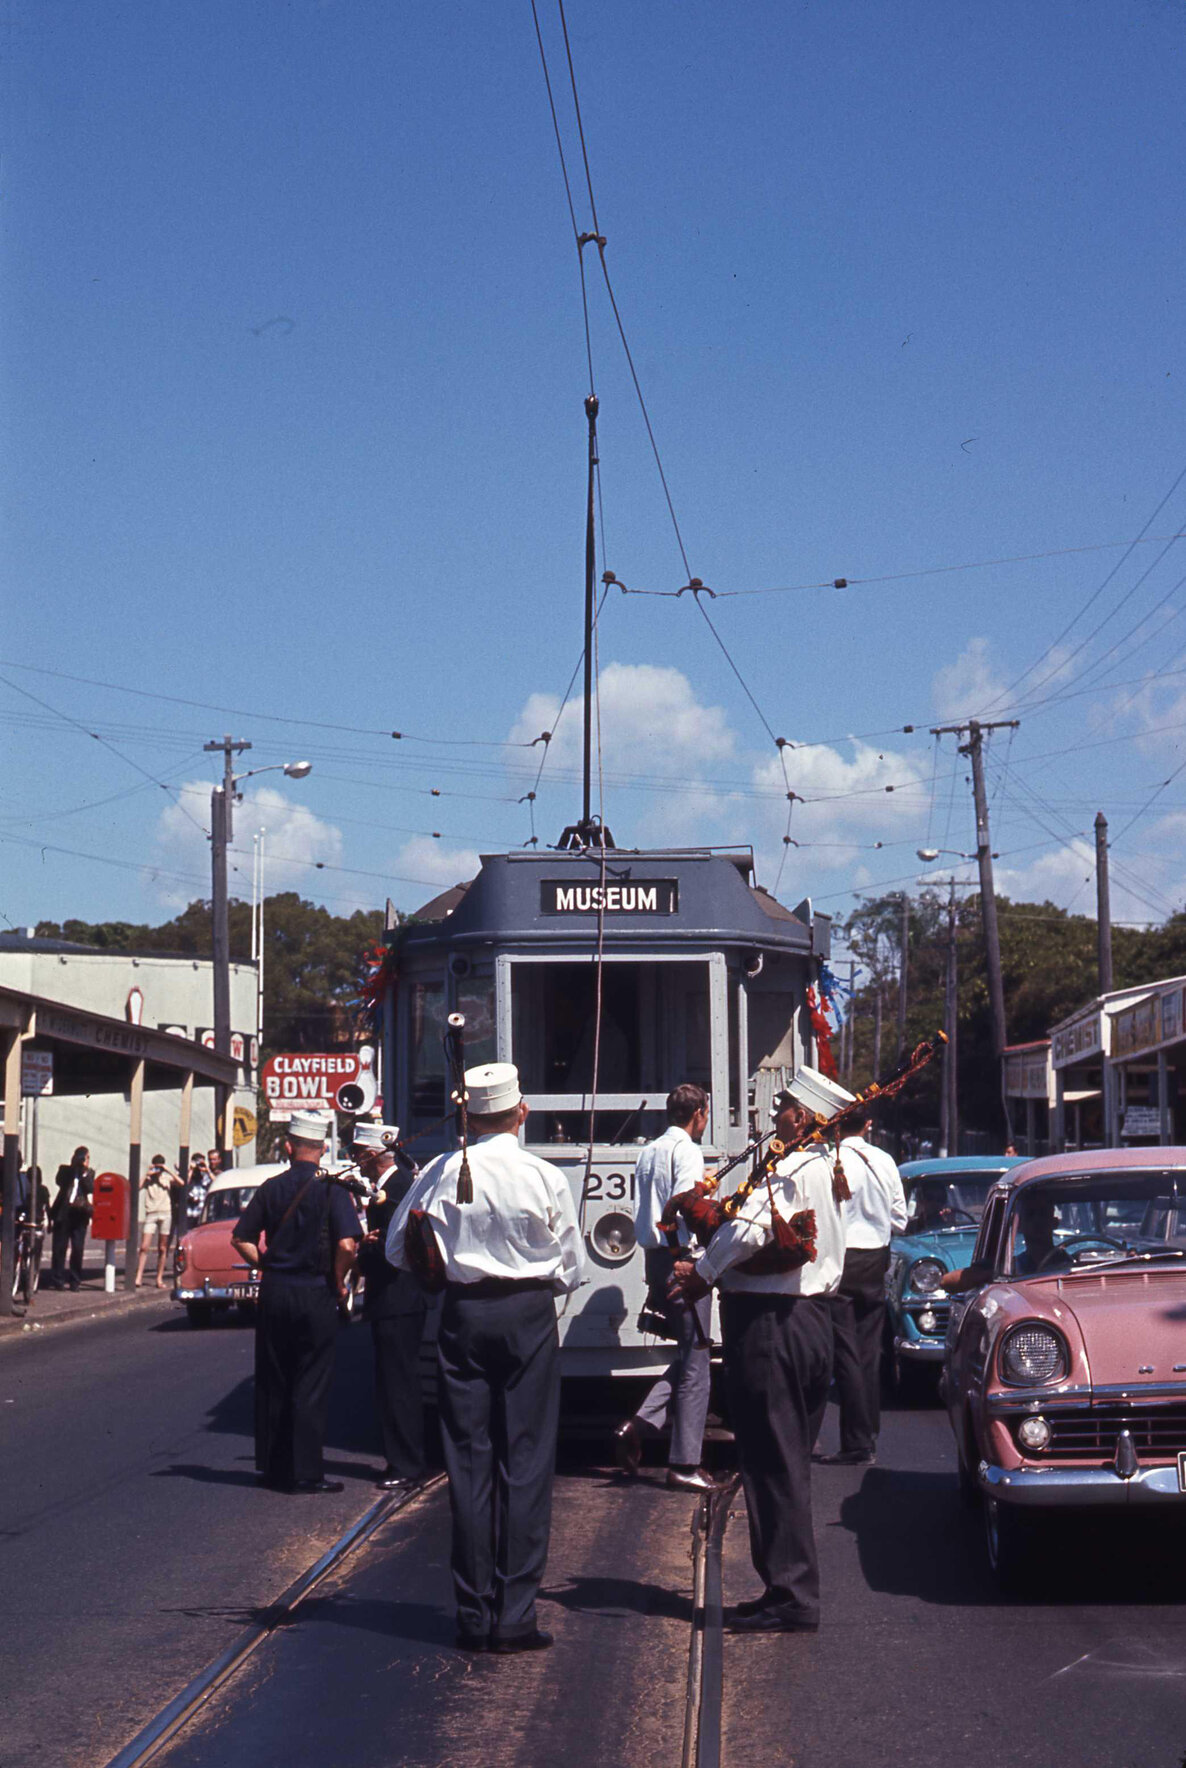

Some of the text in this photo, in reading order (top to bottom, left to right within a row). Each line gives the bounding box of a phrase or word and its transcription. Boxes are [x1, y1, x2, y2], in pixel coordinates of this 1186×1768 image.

[556, 887, 657, 910] MUSEUM
[273, 1057, 356, 1073] CLAYFIELD
[266, 1076, 334, 1098] BOWL
[584, 1172, 636, 1201] 231
